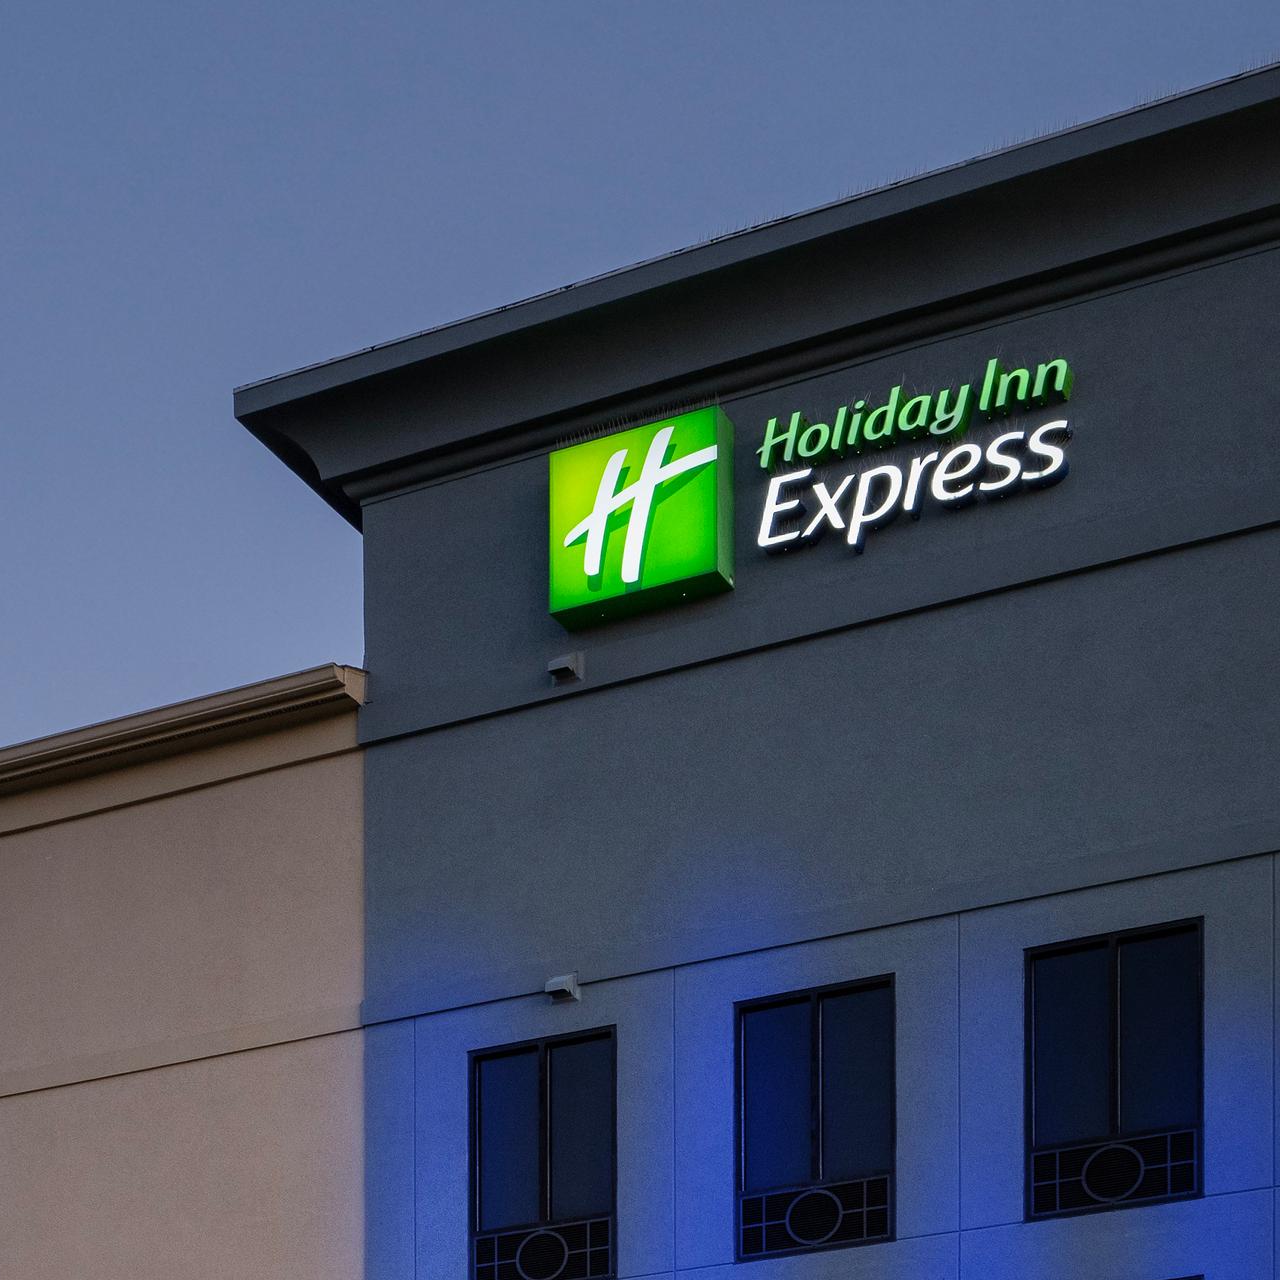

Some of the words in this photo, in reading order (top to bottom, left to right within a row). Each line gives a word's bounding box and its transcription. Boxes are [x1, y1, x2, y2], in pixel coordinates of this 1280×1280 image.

[756, 384, 972, 469] Holiday
[979, 357, 1073, 412] Inn
[757, 419, 1070, 548] Express
